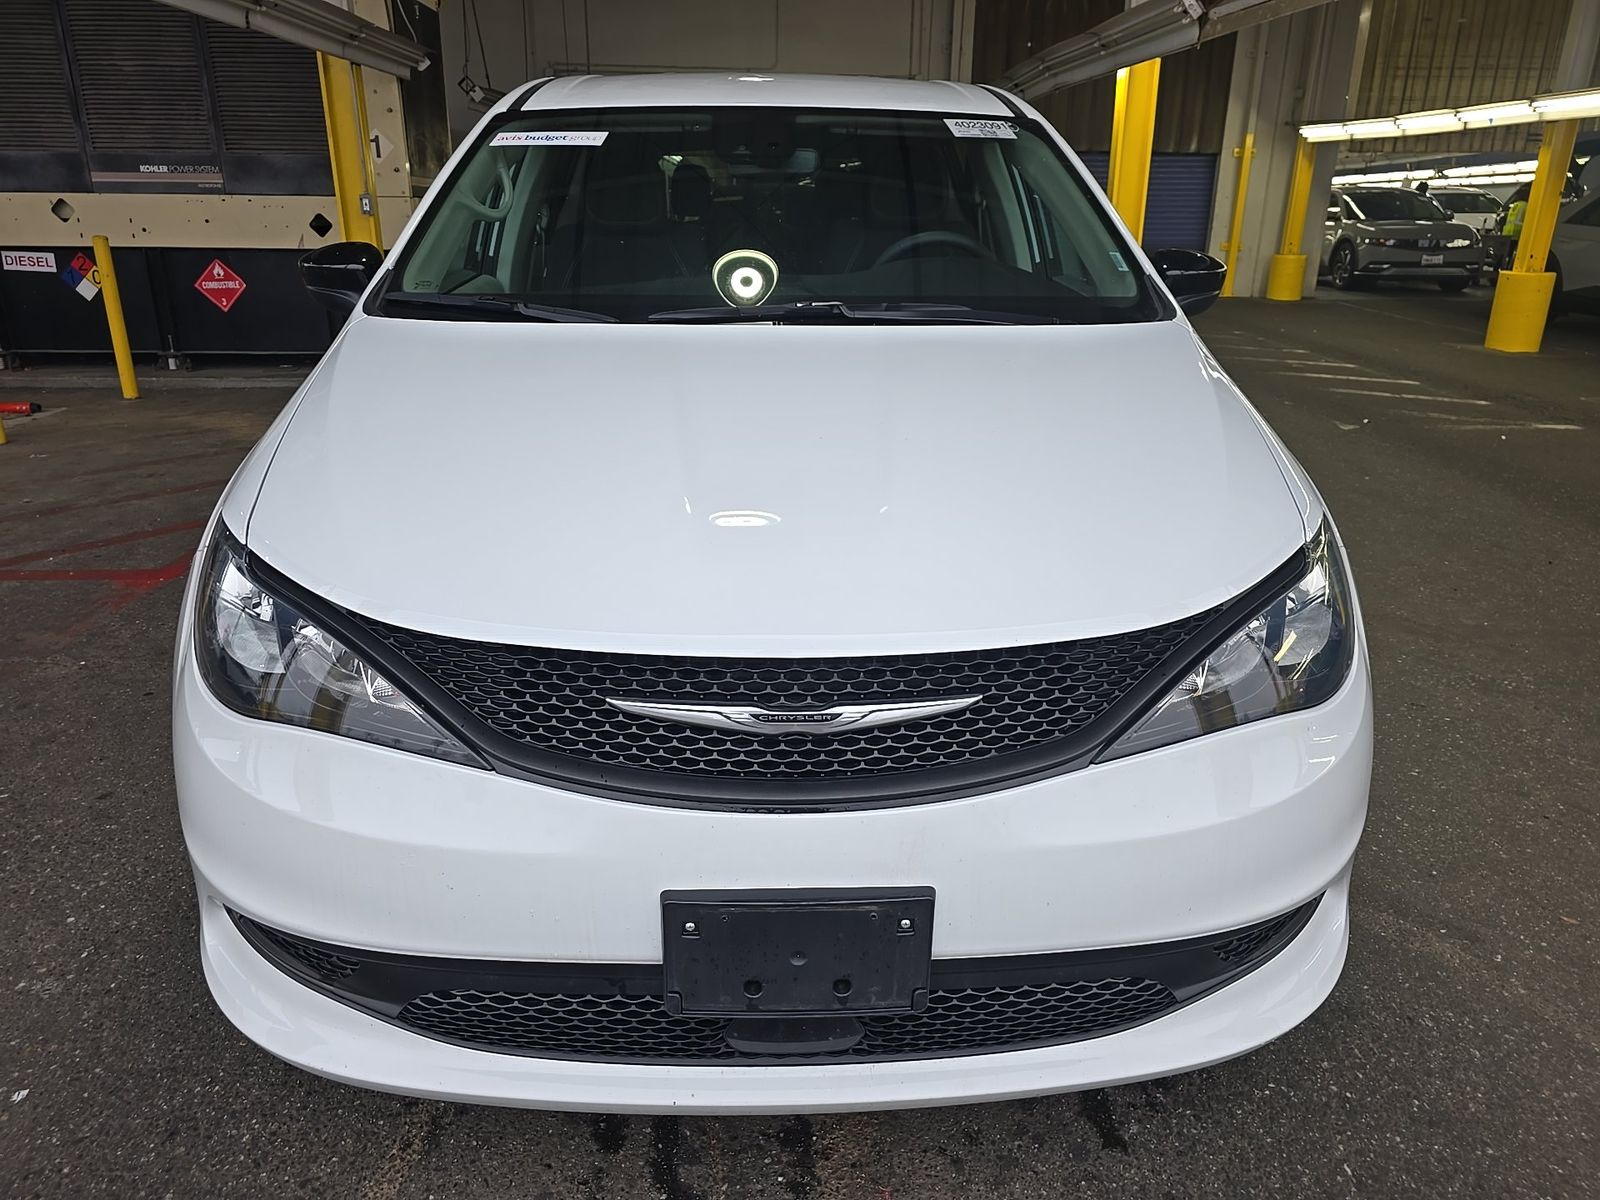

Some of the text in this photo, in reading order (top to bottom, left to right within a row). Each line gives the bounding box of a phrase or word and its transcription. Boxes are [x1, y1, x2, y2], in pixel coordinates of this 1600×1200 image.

[524, 134, 569, 142] budget
[139, 164, 220, 173] KOHLER POWER SYSTEM
[4, 254, 54, 268] DIESEL
[76, 255, 88, 272] 2
[202, 281, 240, 289] COMBUSTIBLE
[221, 297, 228, 306] 3
